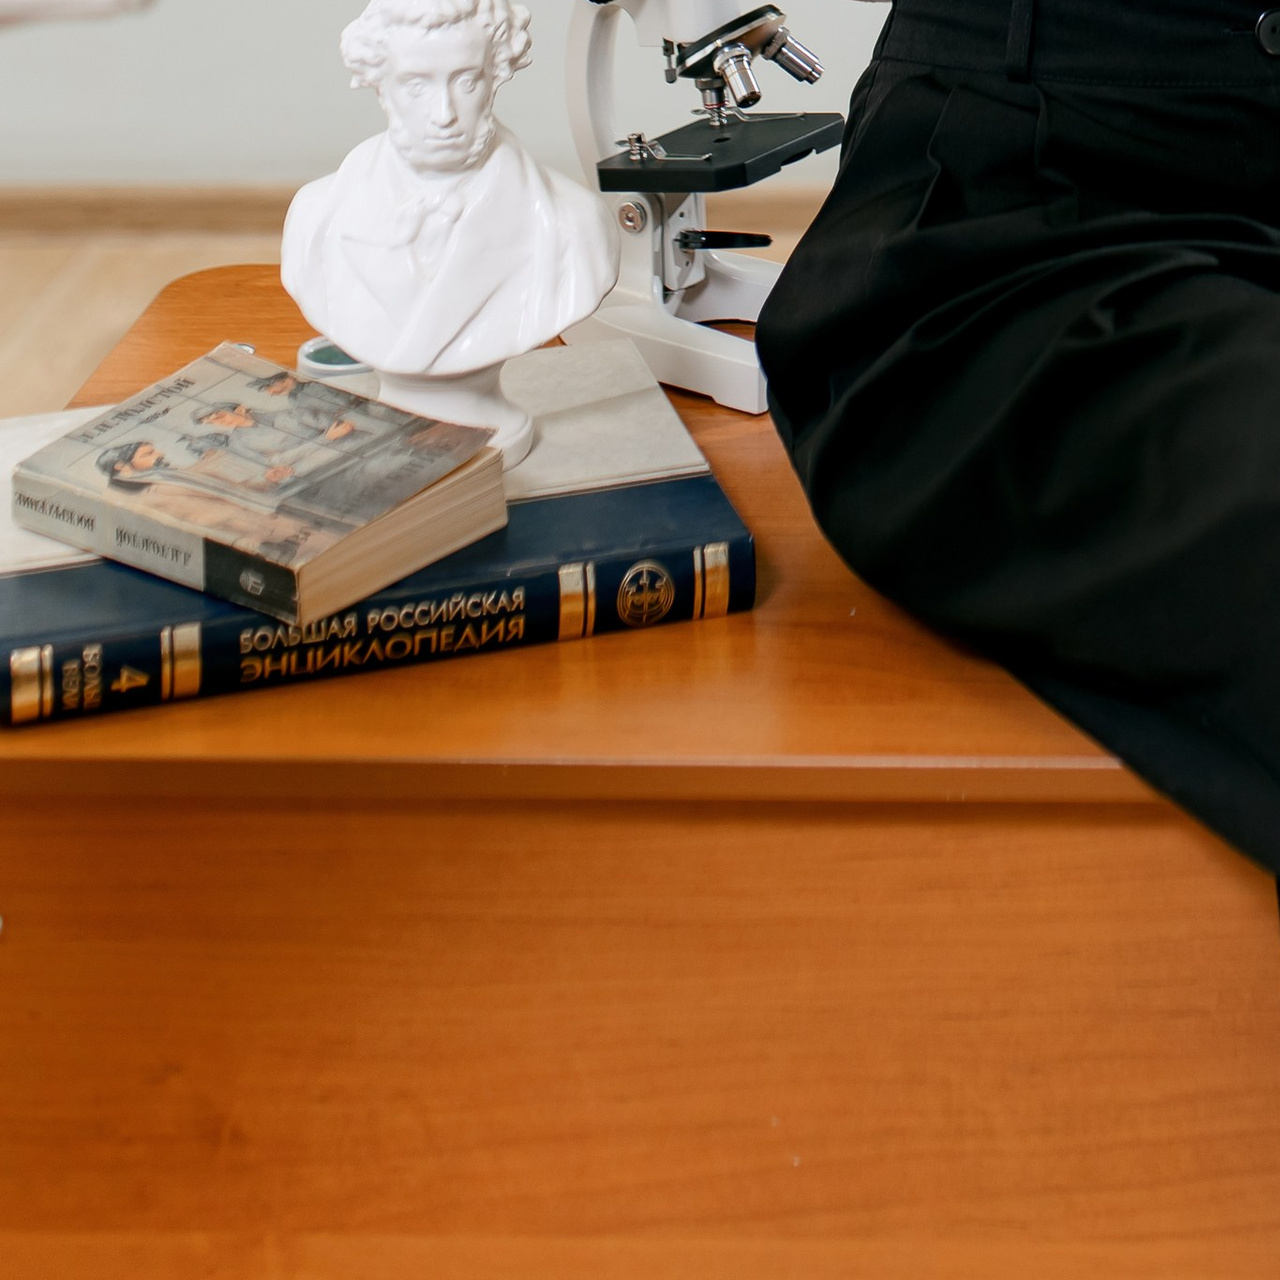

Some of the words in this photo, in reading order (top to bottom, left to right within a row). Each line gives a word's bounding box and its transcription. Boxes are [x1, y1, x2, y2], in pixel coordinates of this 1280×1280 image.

[240, 612, 357, 654] БОЛЬШАЯ
[366, 586, 525, 635] РОССИЙСКАЯ
[240, 614, 526, 683] ЭНЦИКЛОПЕДИЯ
[110, 664, 151, 693] 4
